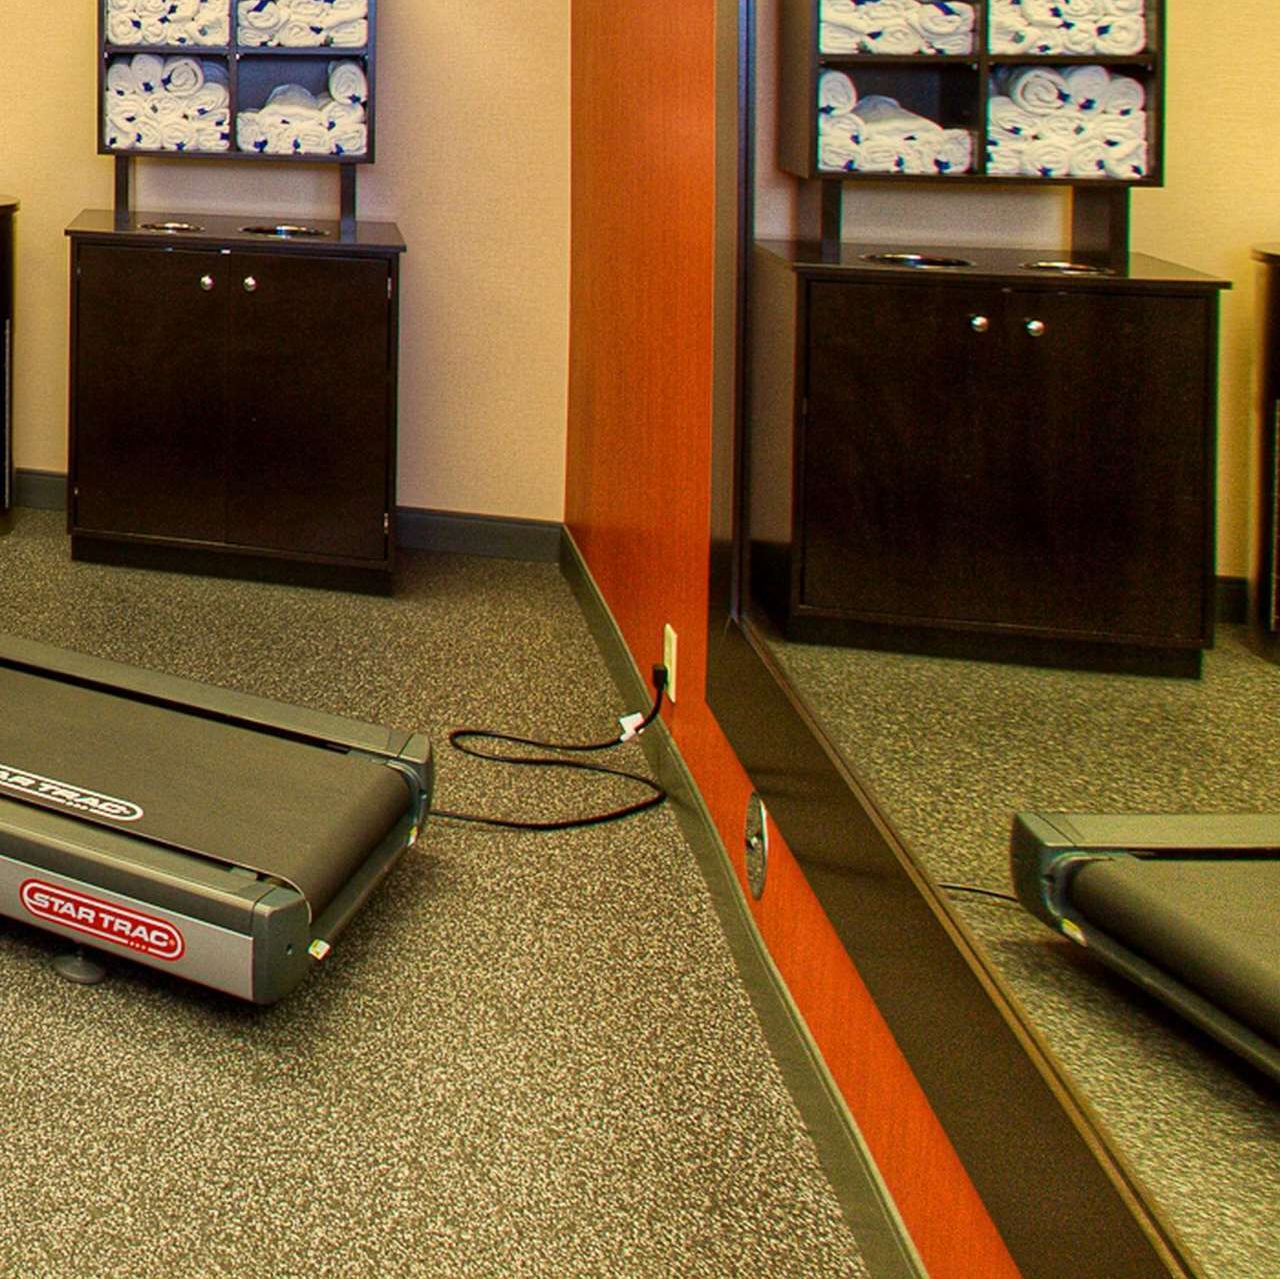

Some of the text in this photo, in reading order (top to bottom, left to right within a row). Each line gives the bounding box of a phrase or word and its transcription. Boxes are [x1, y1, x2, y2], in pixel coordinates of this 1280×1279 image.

[38, 780, 126, 814] TRAC
[31, 892, 170, 948] STAR TRAC
